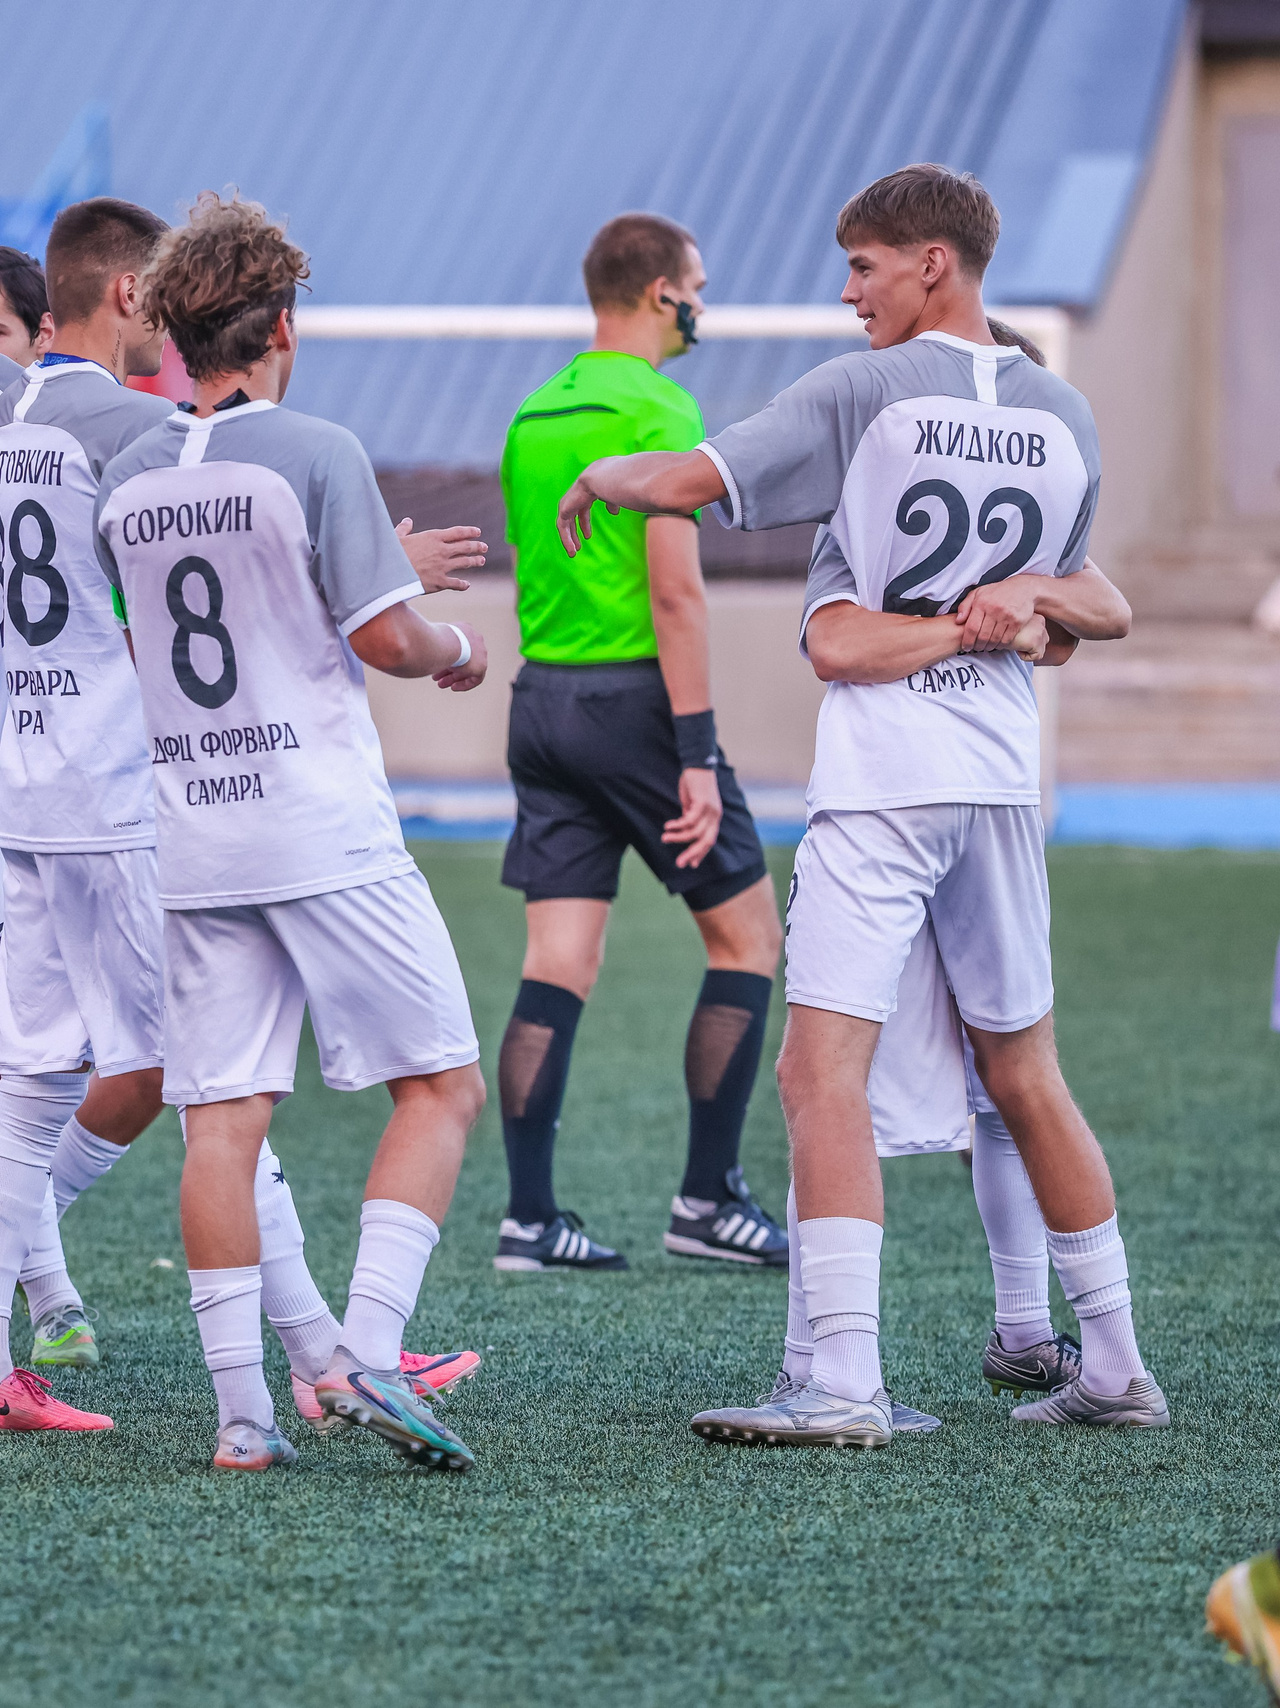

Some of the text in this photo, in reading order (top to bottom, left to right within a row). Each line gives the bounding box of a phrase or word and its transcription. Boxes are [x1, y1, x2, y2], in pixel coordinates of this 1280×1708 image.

[914, 420, 1046, 467] ЖИДКОВ
[123, 496, 253, 546] СОРОКИН
[883, 478, 1044, 618] 22
[165, 555, 238, 709] 8
[6, 670, 81, 697] ОРВАРД
[152, 722, 300, 764] ДФЦ ФОРВАРД
[186, 773, 264, 806] САМАРА
